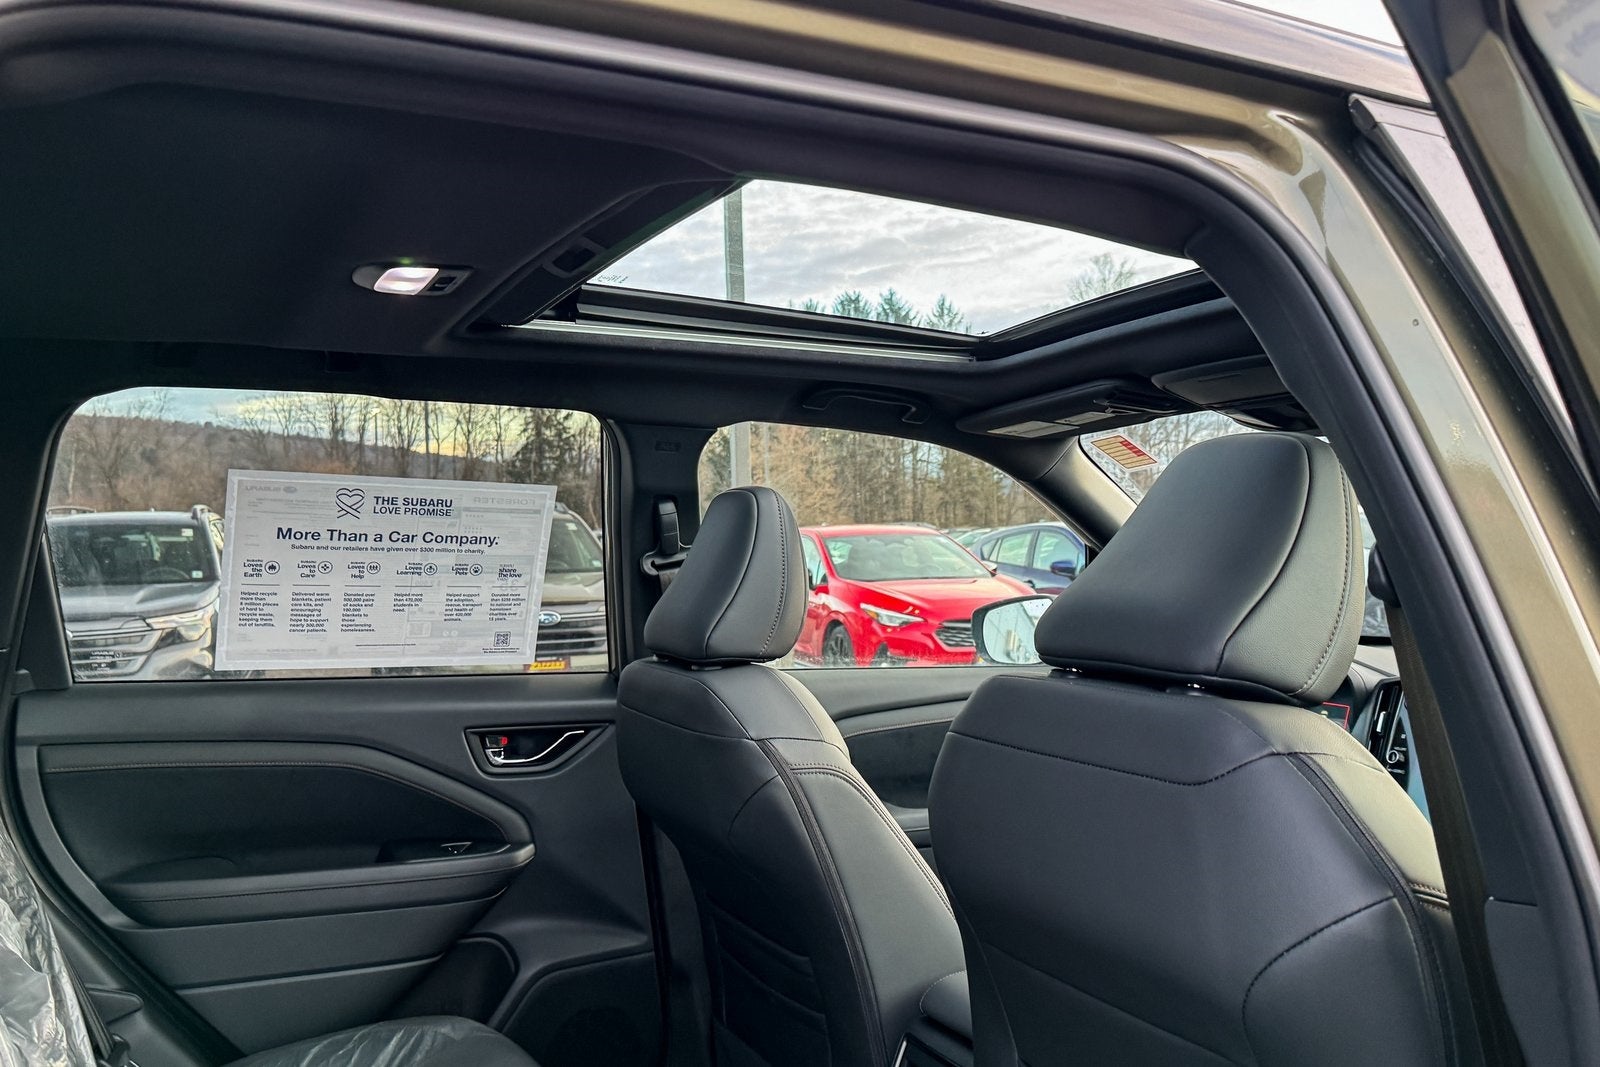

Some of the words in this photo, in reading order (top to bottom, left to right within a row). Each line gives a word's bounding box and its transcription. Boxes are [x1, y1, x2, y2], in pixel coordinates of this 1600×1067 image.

[373, 496, 399, 506] THE
[402, 497, 453, 508] SUBARU
[373, 506, 401, 515] LOVE
[404, 508, 452, 517] PROMISE
[276, 527, 321, 541] More
[326, 529, 368, 542] Than
[373, 533, 383, 543] a
[388, 531, 418, 543] Car
[422, 532, 498, 548] Company.
